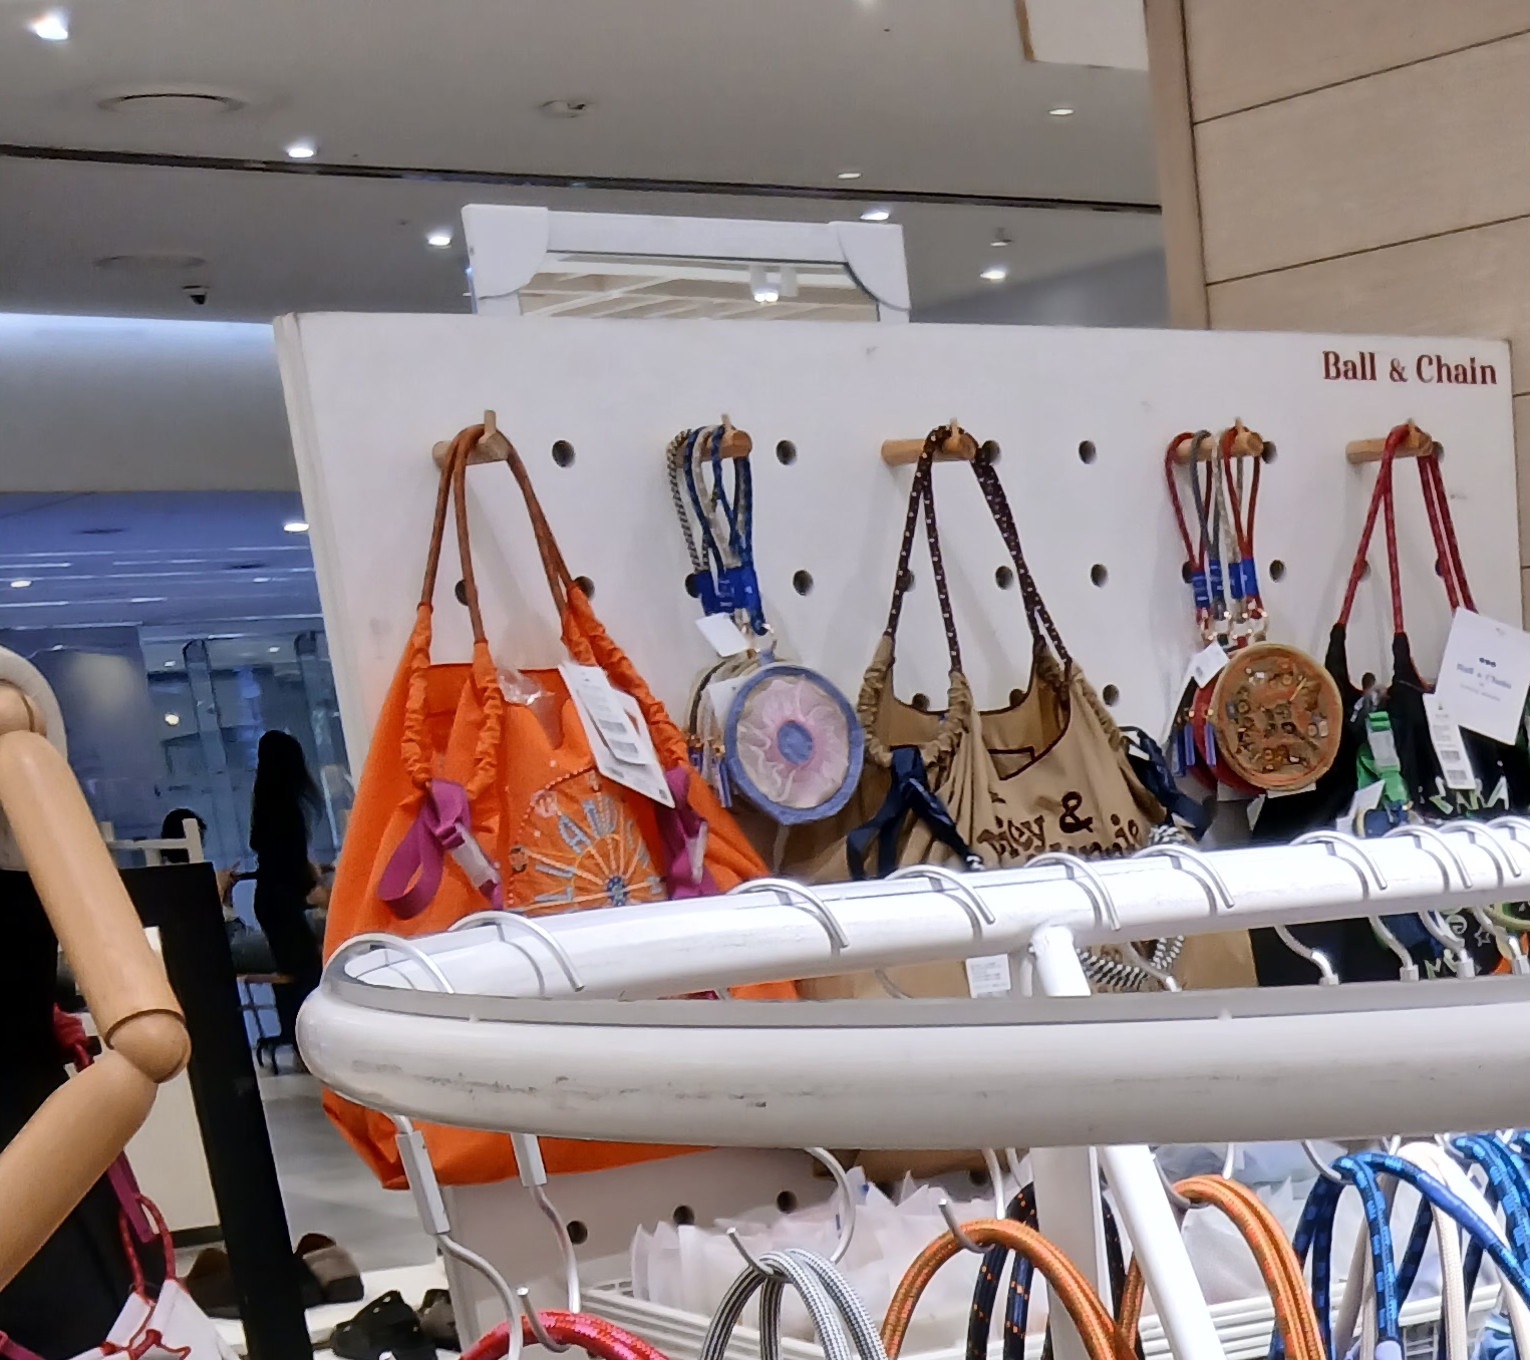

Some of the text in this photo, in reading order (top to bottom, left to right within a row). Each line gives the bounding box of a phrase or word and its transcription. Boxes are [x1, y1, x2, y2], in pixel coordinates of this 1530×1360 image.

[1322, 350, 1497, 384] Ball & Chain
[1059, 791, 1094, 834] &
